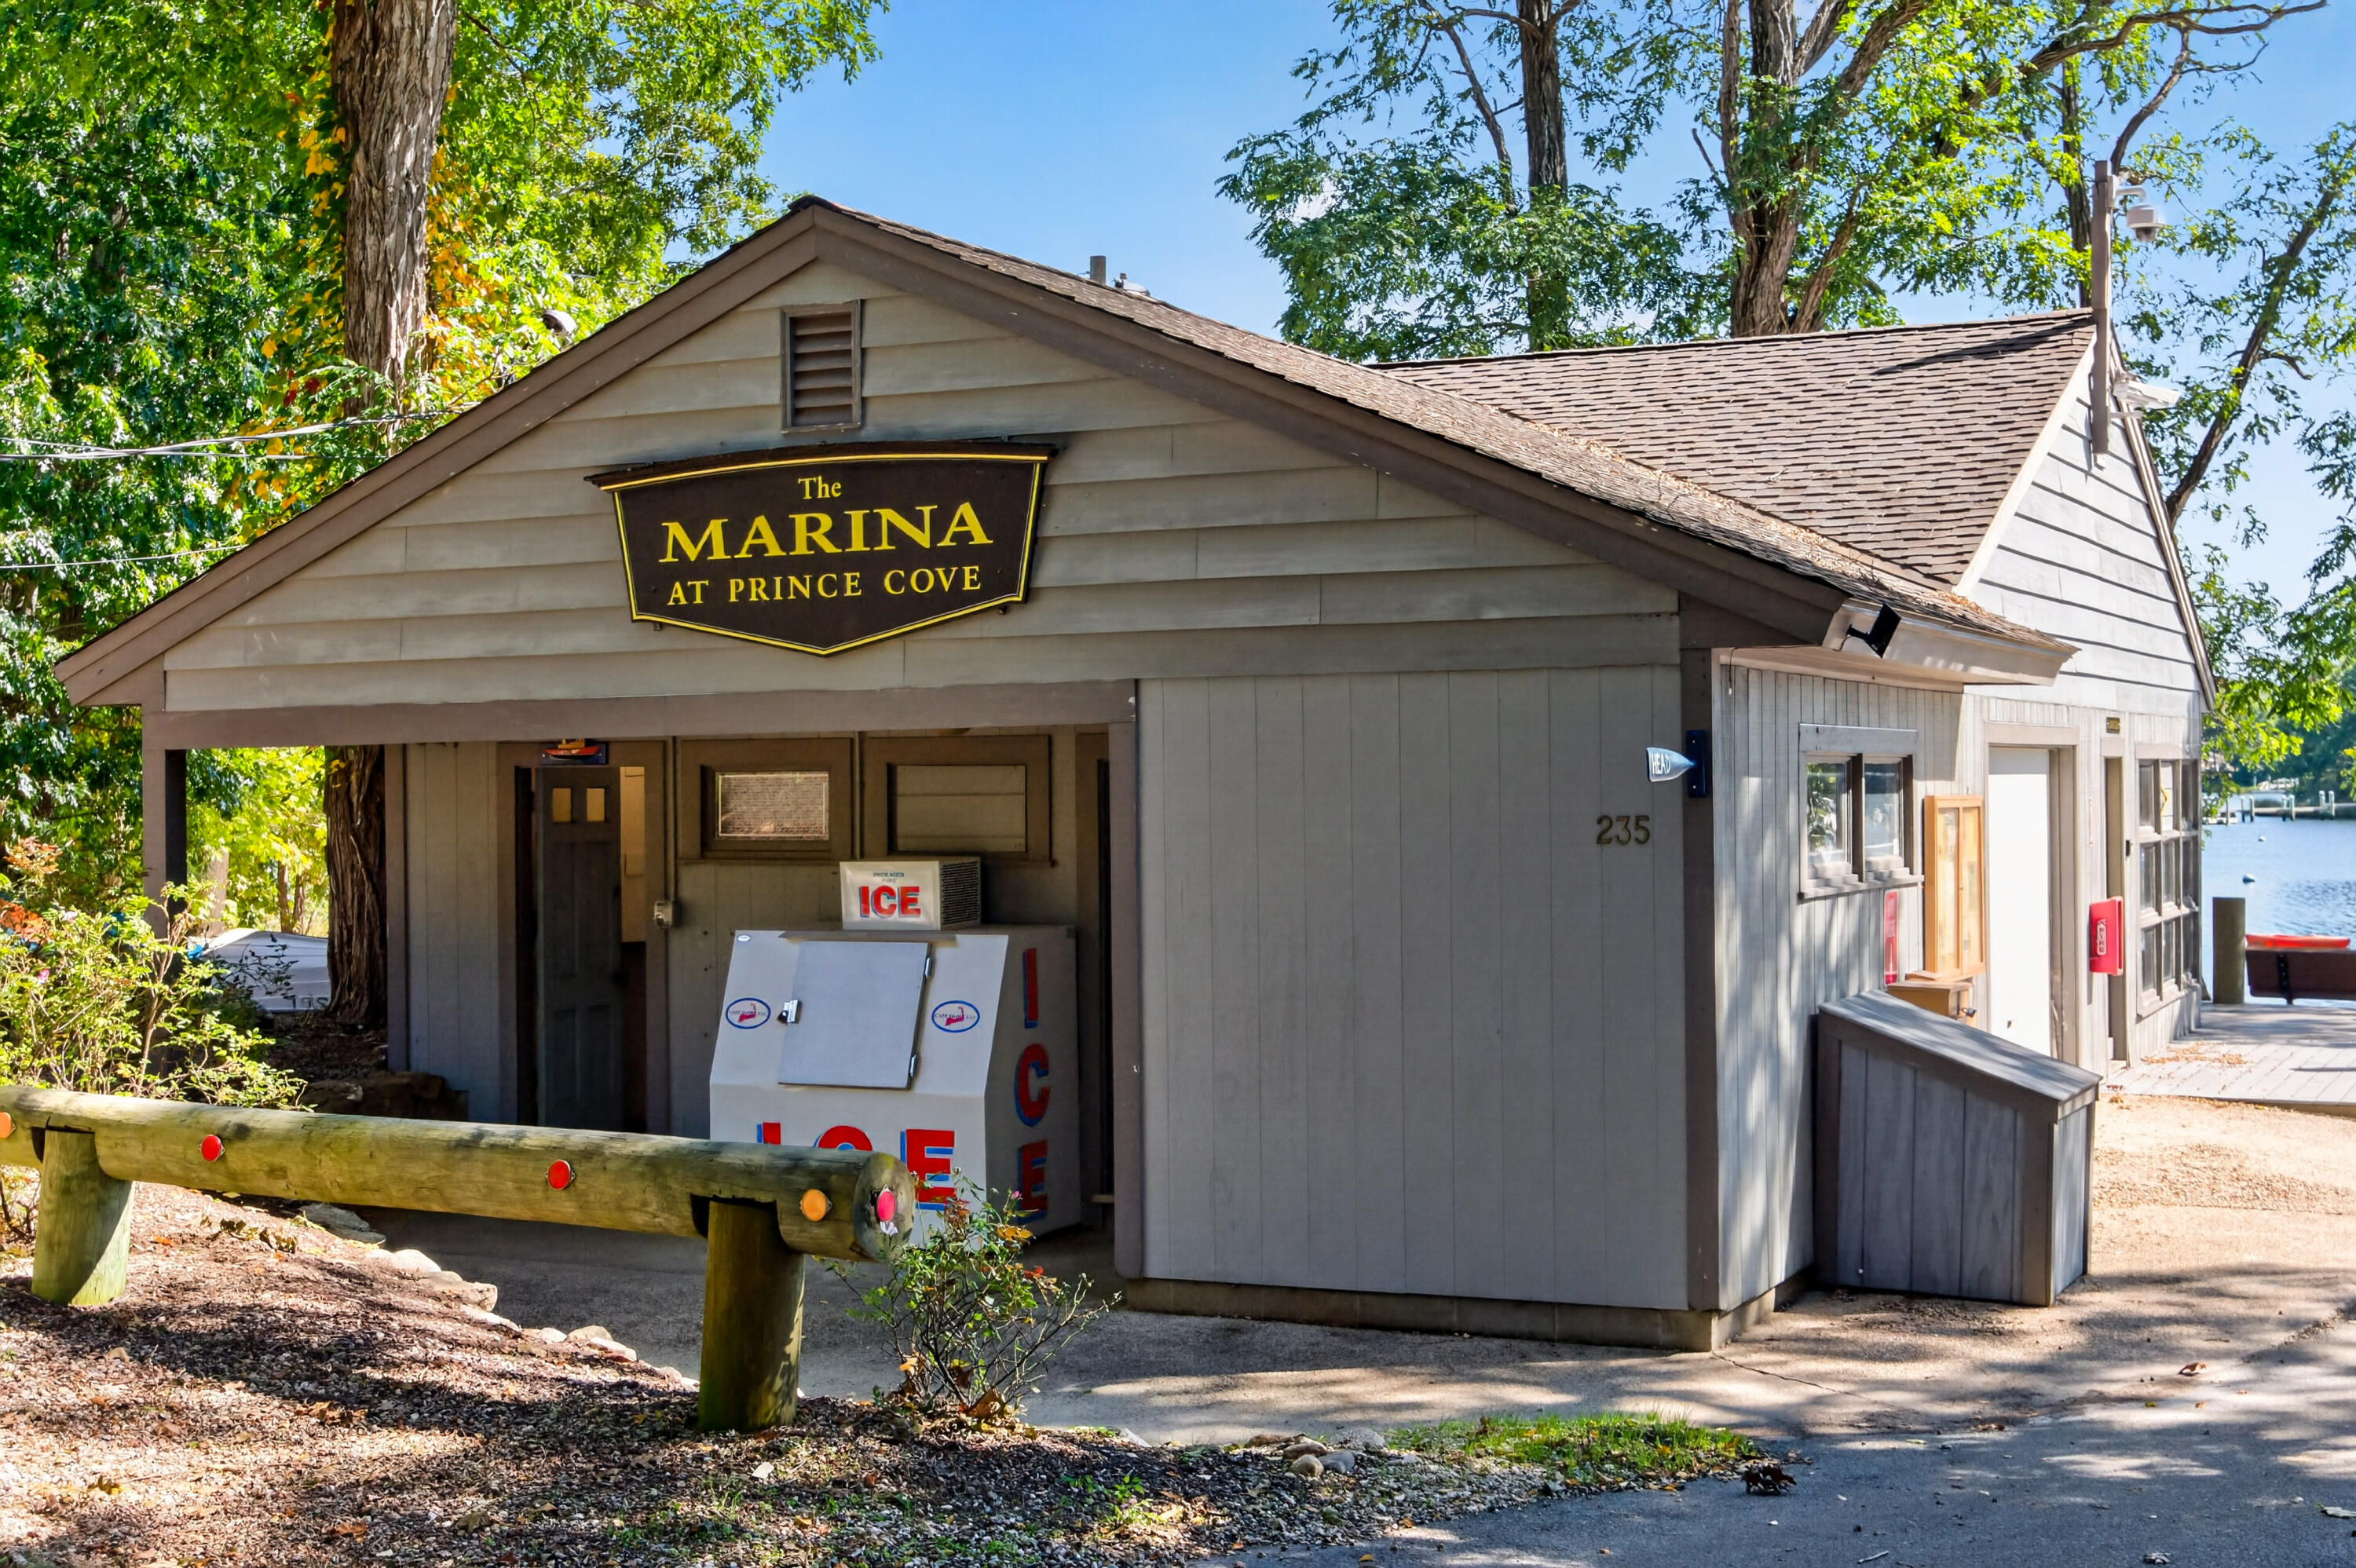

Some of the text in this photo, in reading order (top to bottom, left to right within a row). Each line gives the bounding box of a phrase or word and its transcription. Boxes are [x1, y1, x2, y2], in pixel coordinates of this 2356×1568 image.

[798, 476, 842, 499] The
[659, 501, 993, 563] MARINA
[667, 565, 981, 605] AT PRINCE COVE
[1652, 752, 1670, 775] HEAD
[1596, 815, 1651, 845] 235
[859, 885, 920, 918] ICE
[1015, 948, 1049, 1225] ICE
